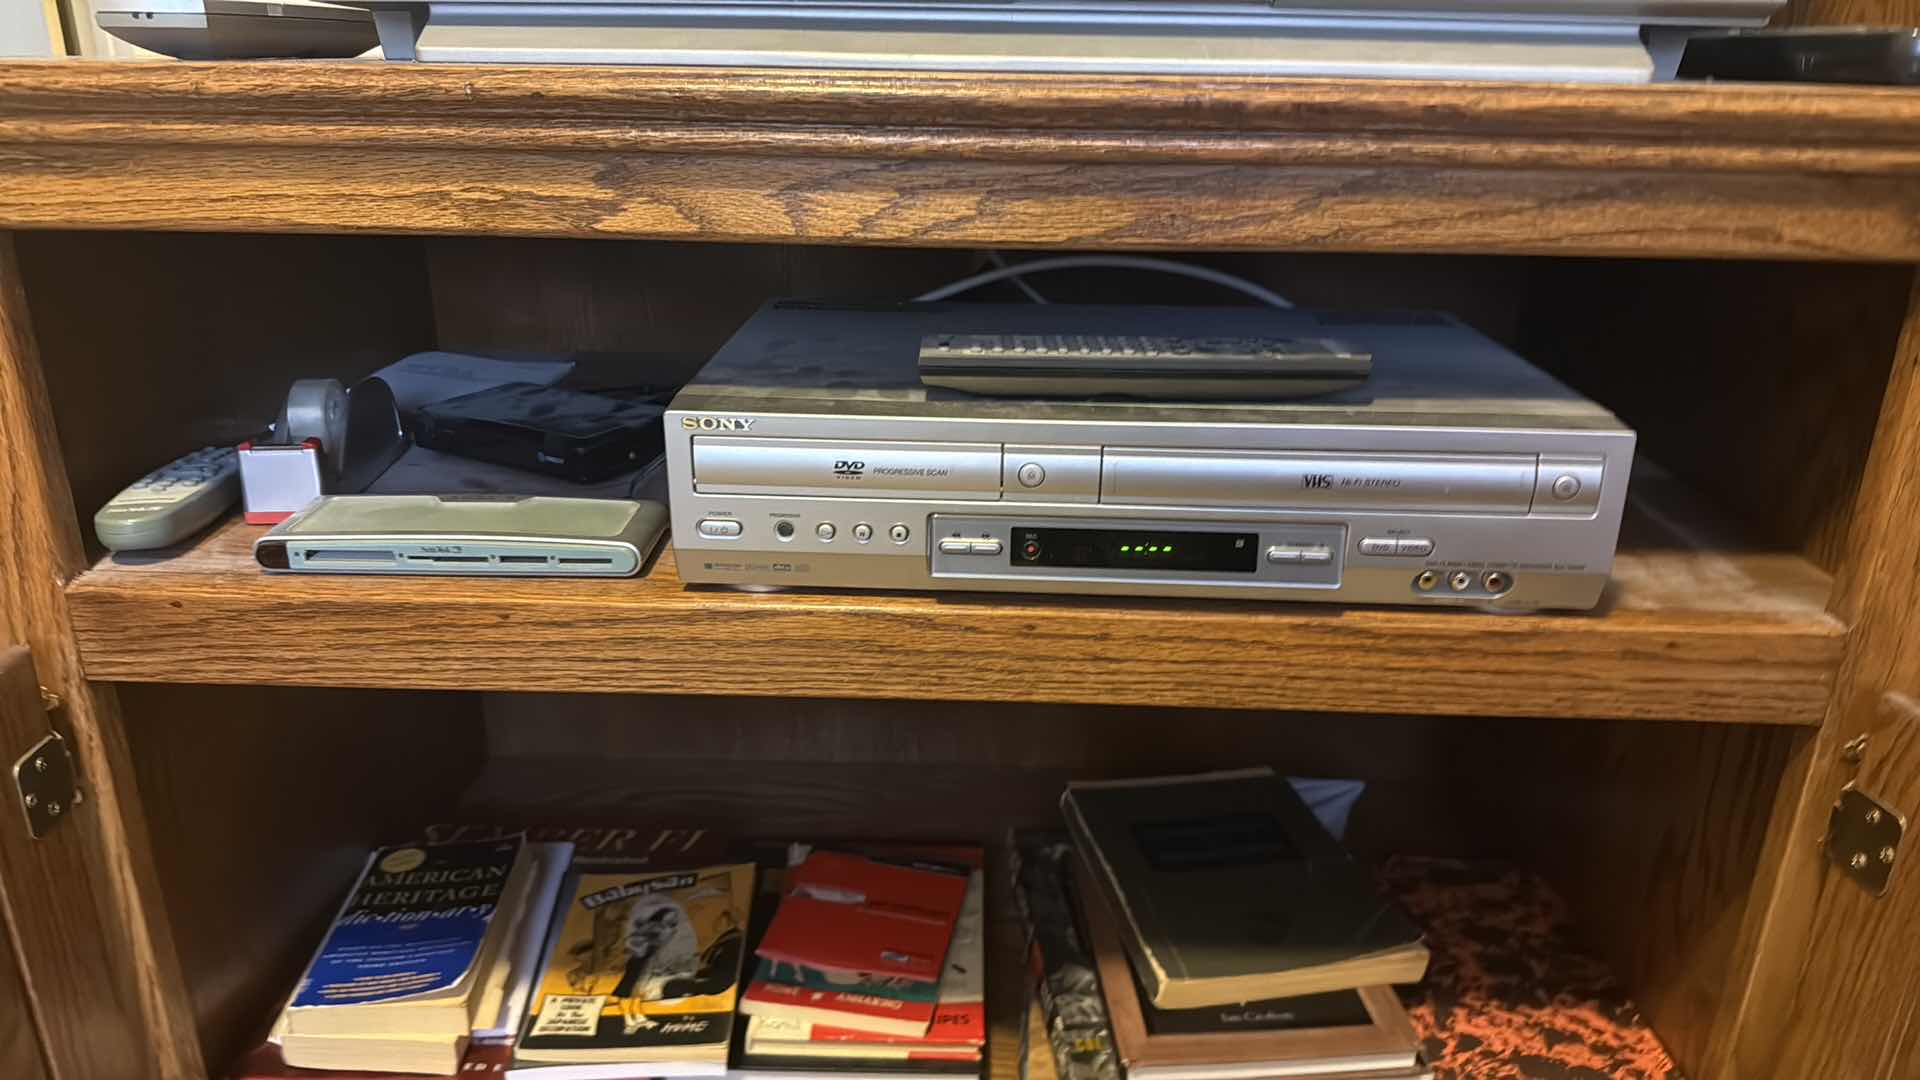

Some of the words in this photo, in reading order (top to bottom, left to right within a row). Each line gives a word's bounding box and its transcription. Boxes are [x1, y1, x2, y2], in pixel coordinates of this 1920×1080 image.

[681, 415, 755, 432] SONY
[833, 459, 865, 470] DVD
[872, 467, 925, 477] PROGRESSIVE
[926, 468, 949, 477] SCAN
[1303, 473, 1332, 489] VHS
[365, 863, 507, 889] AMERICAN
[352, 883, 500, 907] HERITAGE
